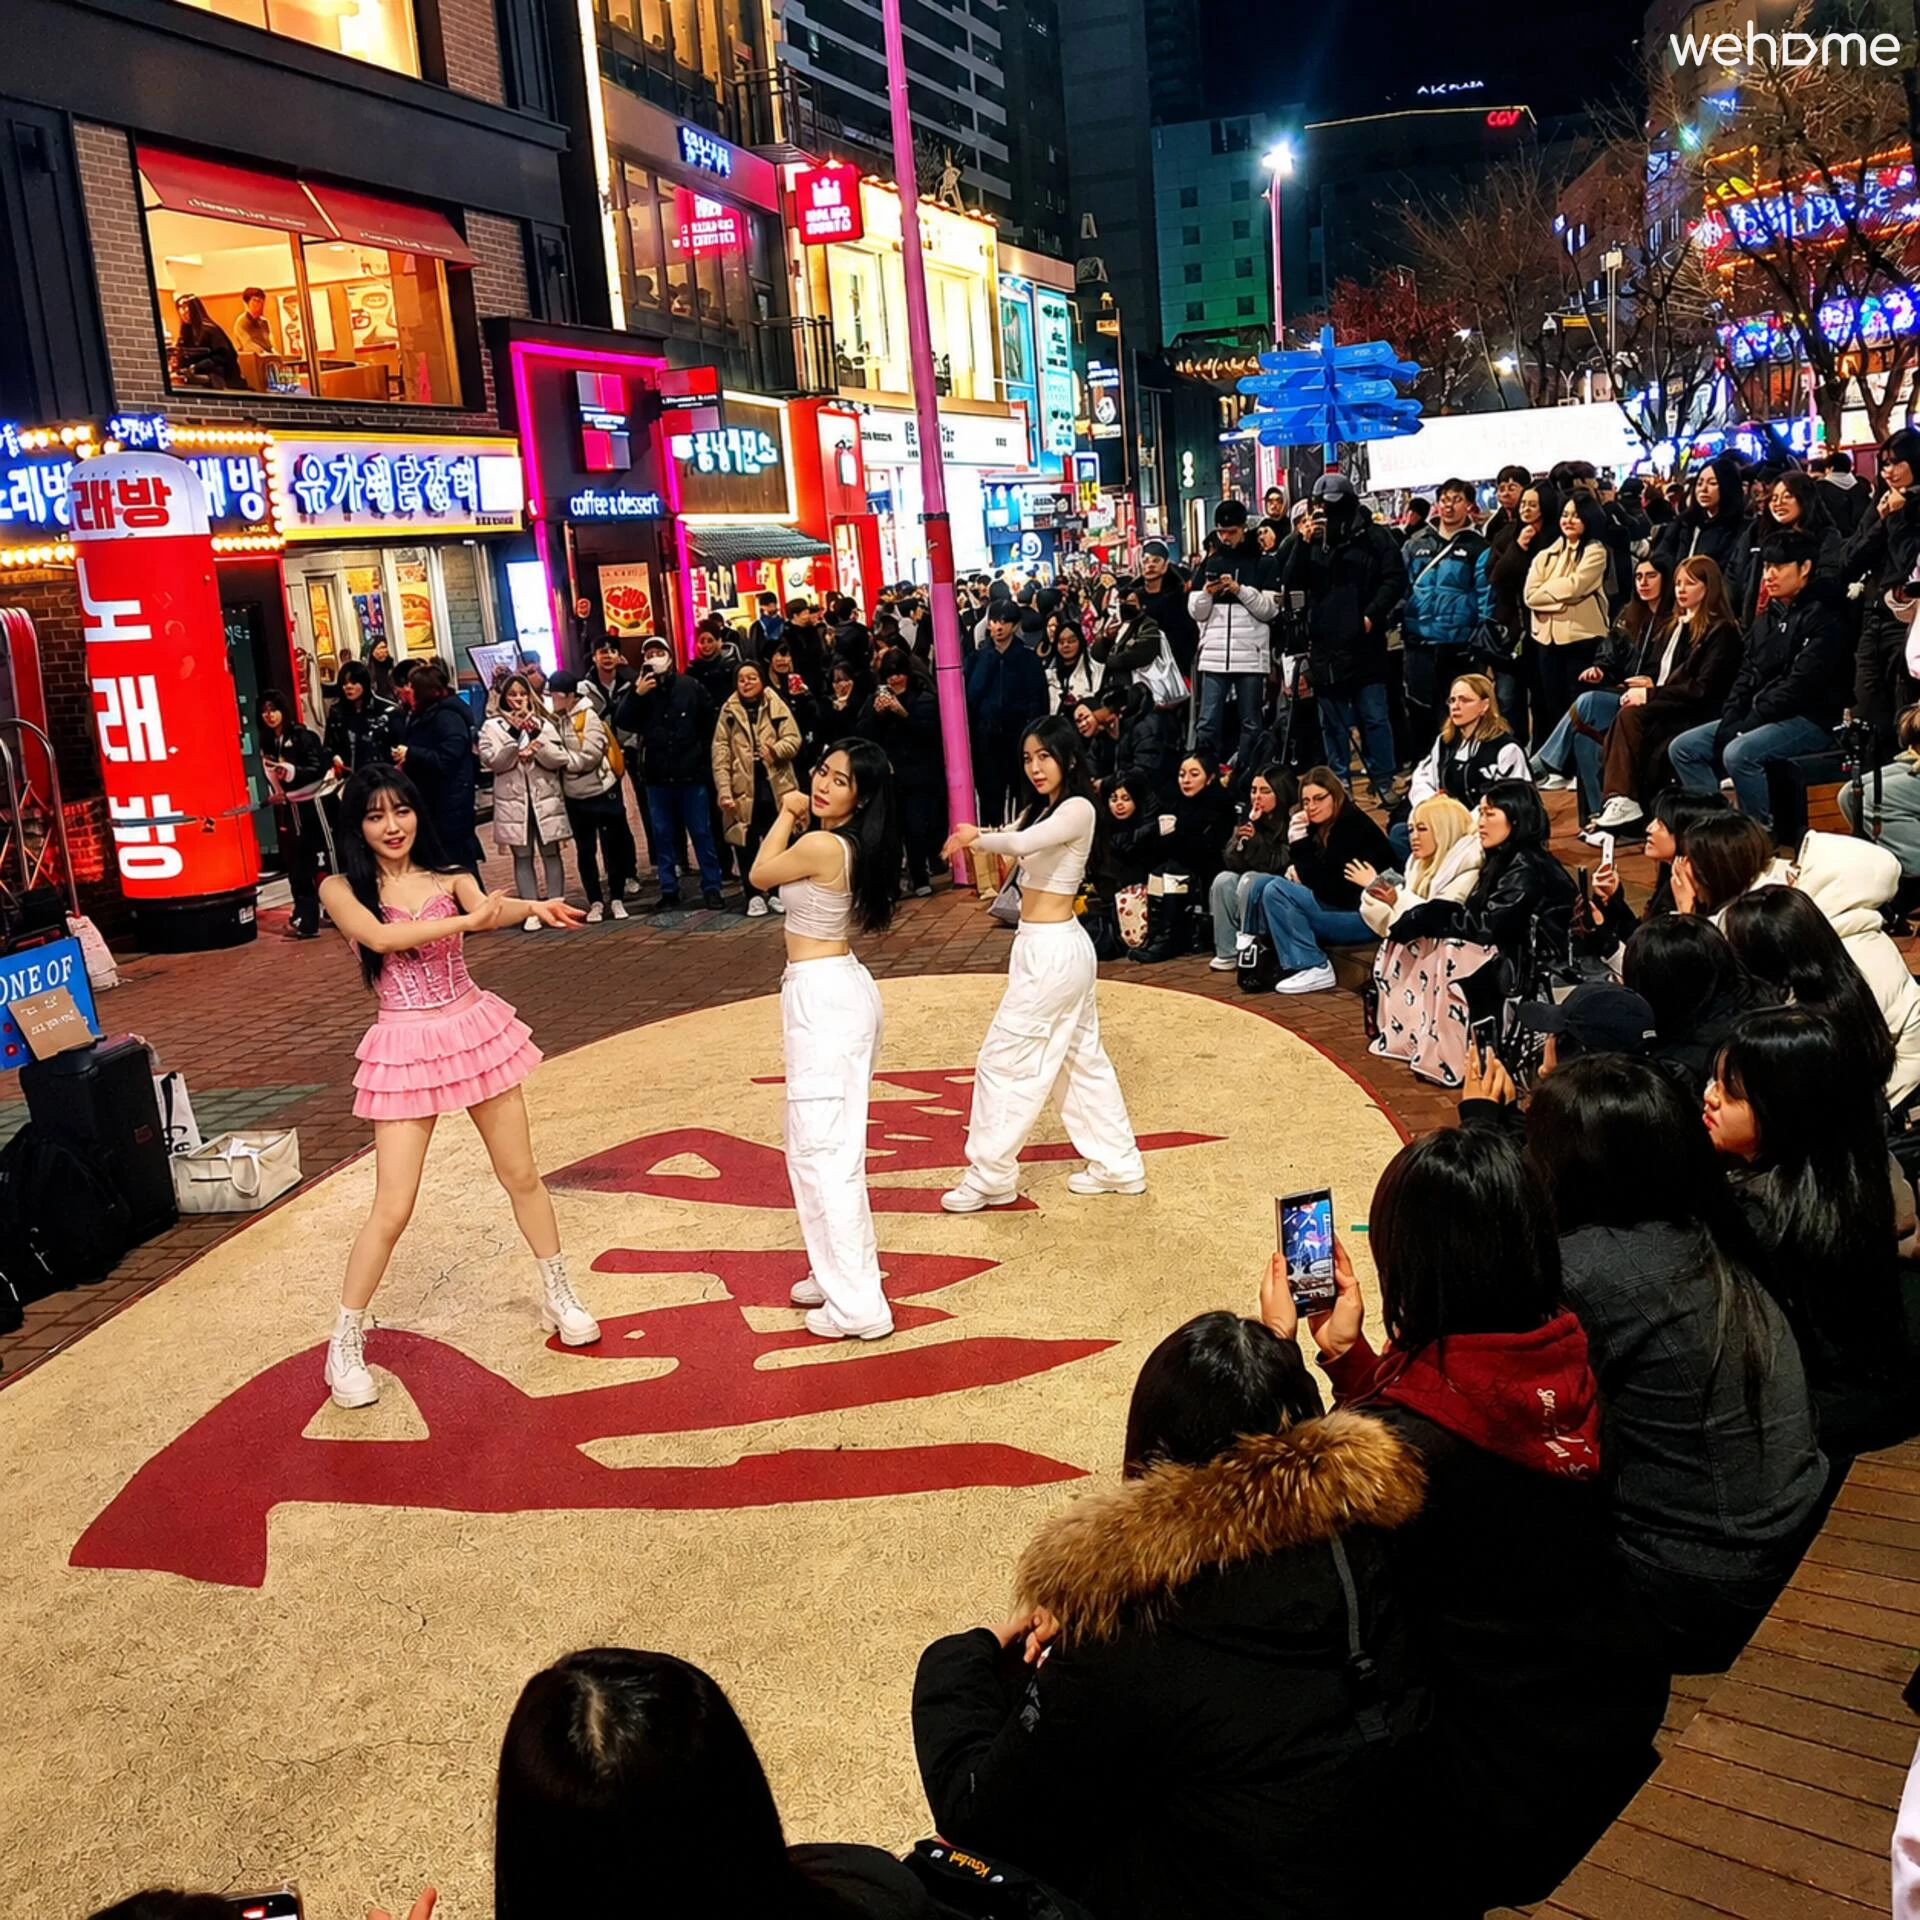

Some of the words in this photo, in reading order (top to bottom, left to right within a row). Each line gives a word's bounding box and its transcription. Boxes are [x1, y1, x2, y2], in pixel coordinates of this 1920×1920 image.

[1417, 83, 1447, 95] AK
[1448, 80, 1485, 91] PLAZA
[1486, 110, 1521, 127] CGV
[570, 489, 608, 516] coffee
[619, 489, 660, 516] dessert
[46, 954, 73, 987] OF
